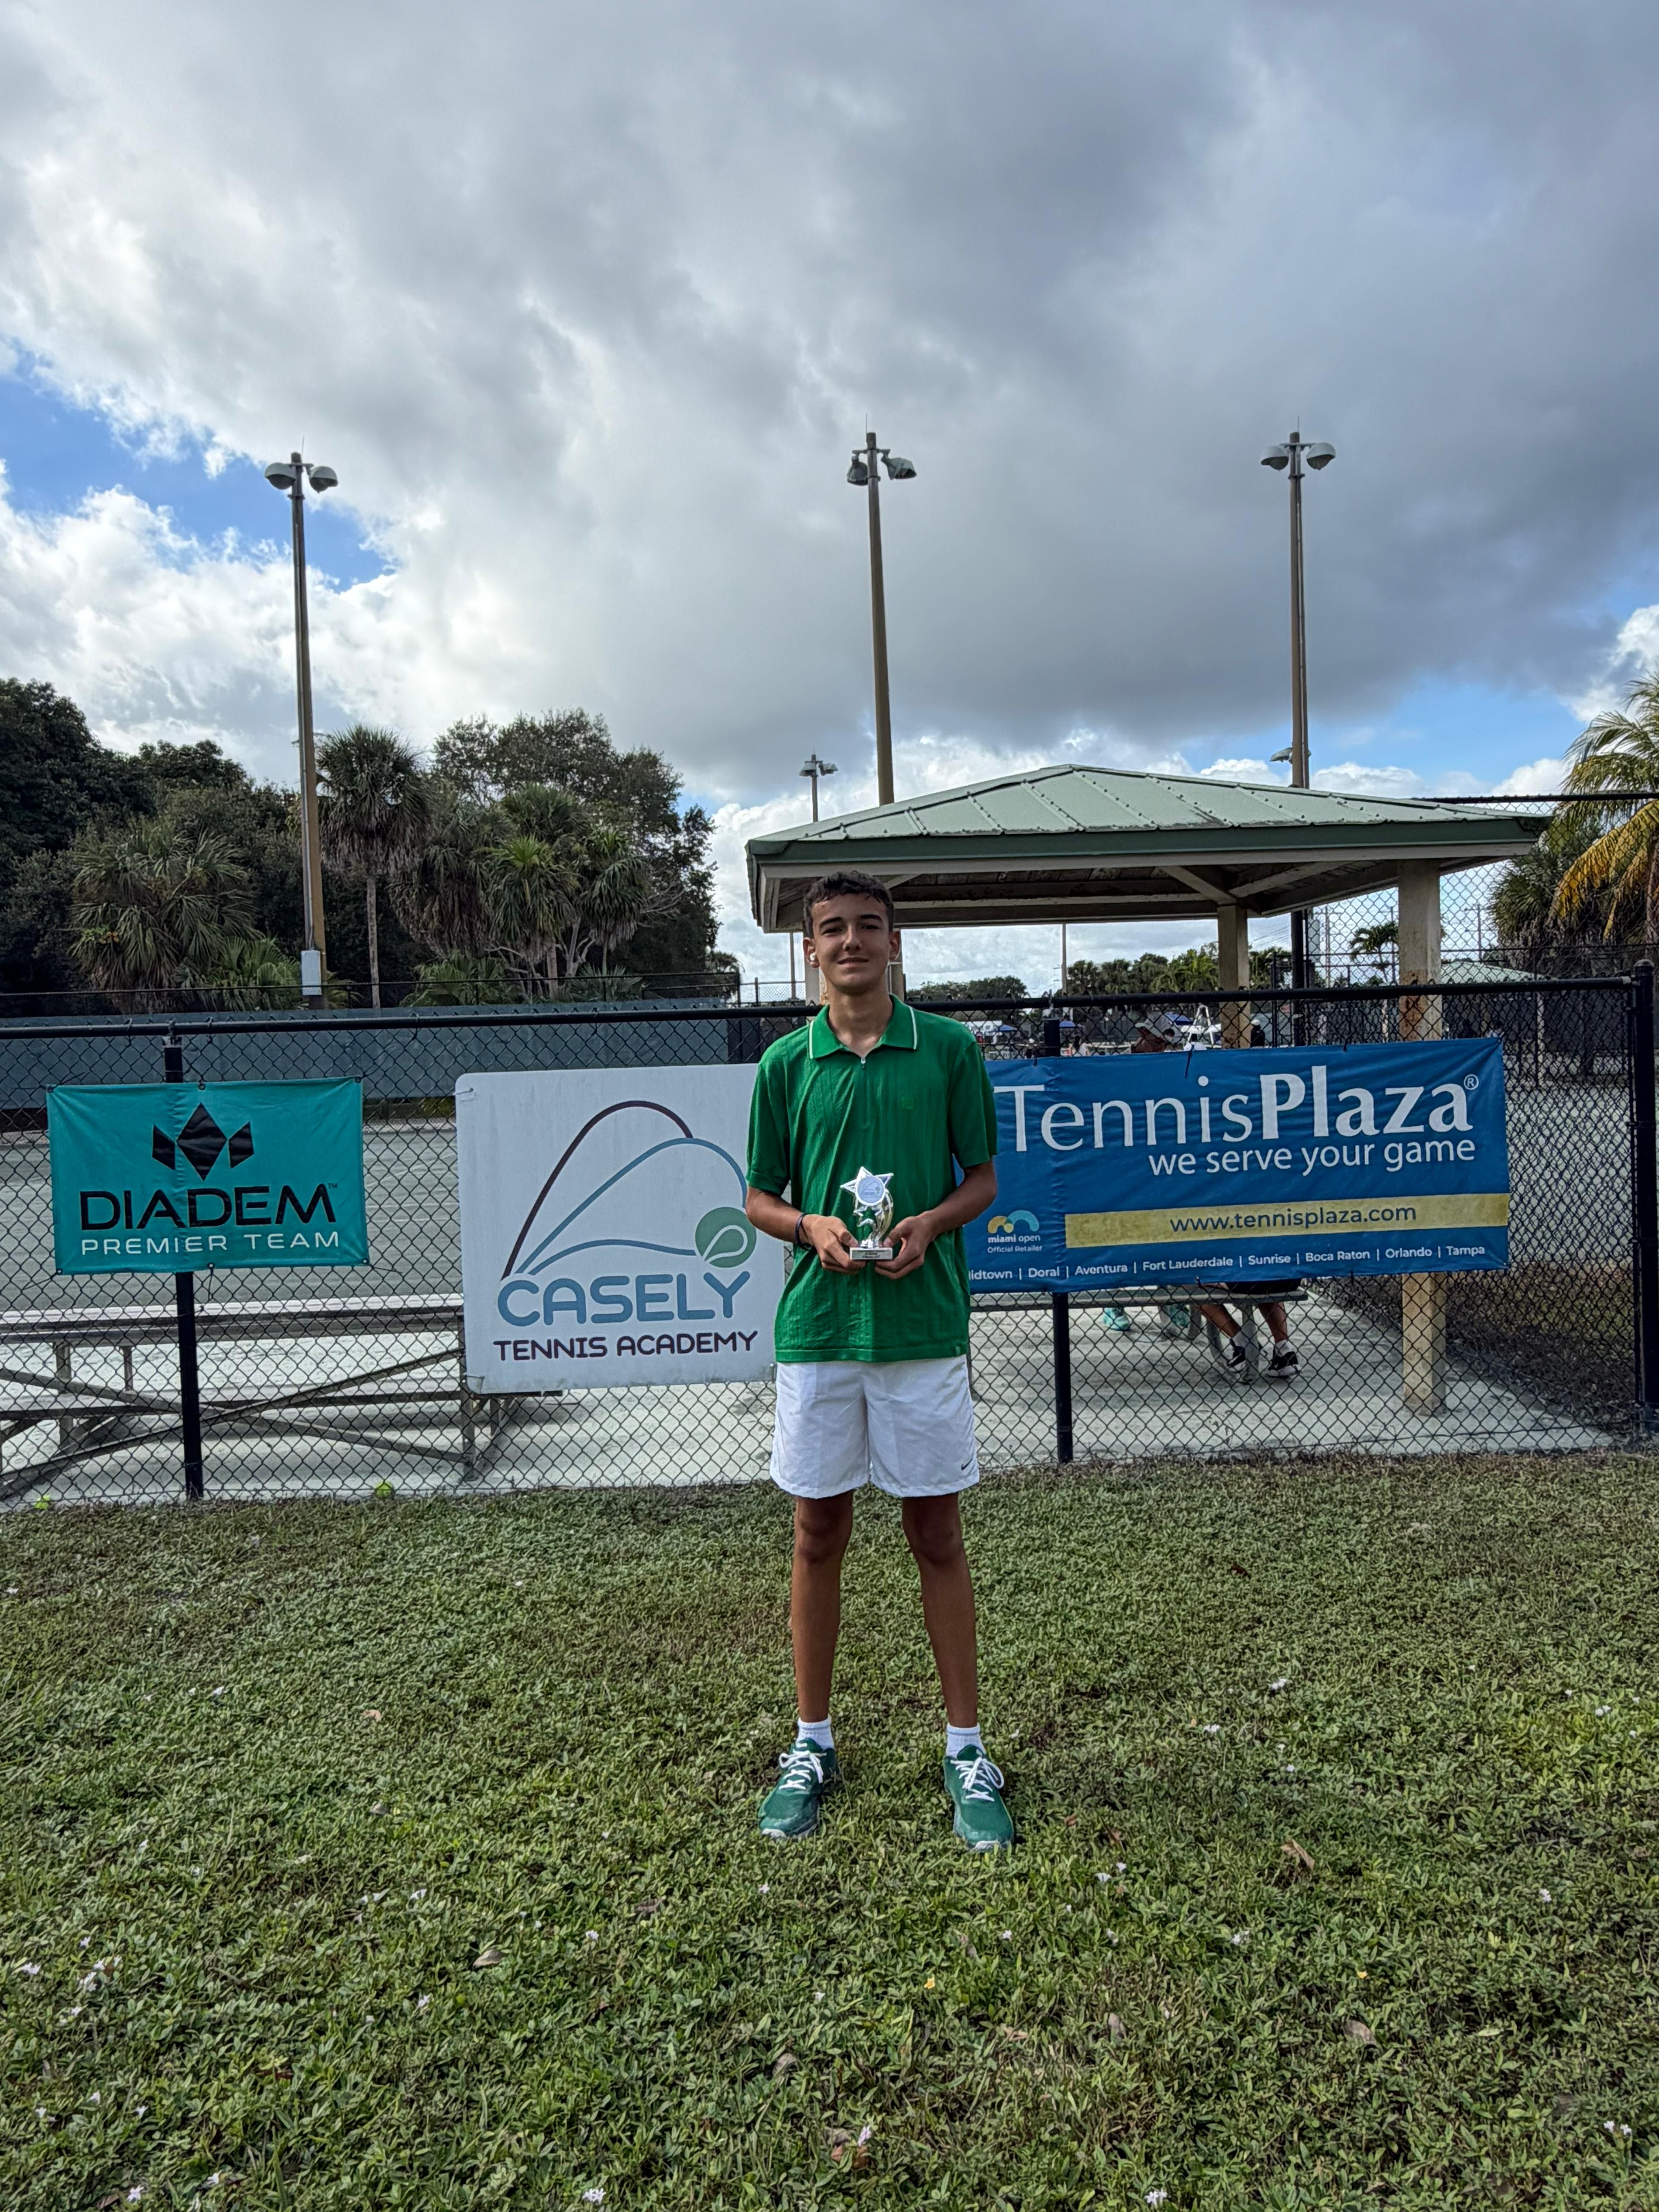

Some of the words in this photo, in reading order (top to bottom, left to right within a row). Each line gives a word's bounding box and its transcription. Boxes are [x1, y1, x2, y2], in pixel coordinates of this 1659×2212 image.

[1148, 1152, 1195, 1176] we
[1206, 1147, 1292, 1174] serve
[1301, 1144, 1375, 1176] your
[1384, 1139, 1475, 1172] game
[1170, 1206, 1416, 1232] www.tennisplaza.com
[82, 1235, 227, 1255] PREMIER
[244, 1231, 339, 1250] TEAM
[988, 1234, 1016, 1243] miami
[1018, 1234, 1041, 1243] open
[1028, 1266, 1060, 1278] Doral
[1075, 1264, 1128, 1275] Aventura
[1143, 1261, 1166, 1271] Fort
[1169, 1256, 1233, 1269] Lauderdale
[1248, 1254, 1291, 1265] Sunrise
[1306, 1252, 1334, 1262] Boca
[1337, 1250, 1370, 1261] Raton
[1385, 1247, 1432, 1259] Orlando
[1446, 1245, 1485, 1257] Tampa
[497, 1271, 750, 1327] CASELY
[493, 1336, 607, 1361] TENNIS
[617, 1330, 758, 1357] ACADEMY
